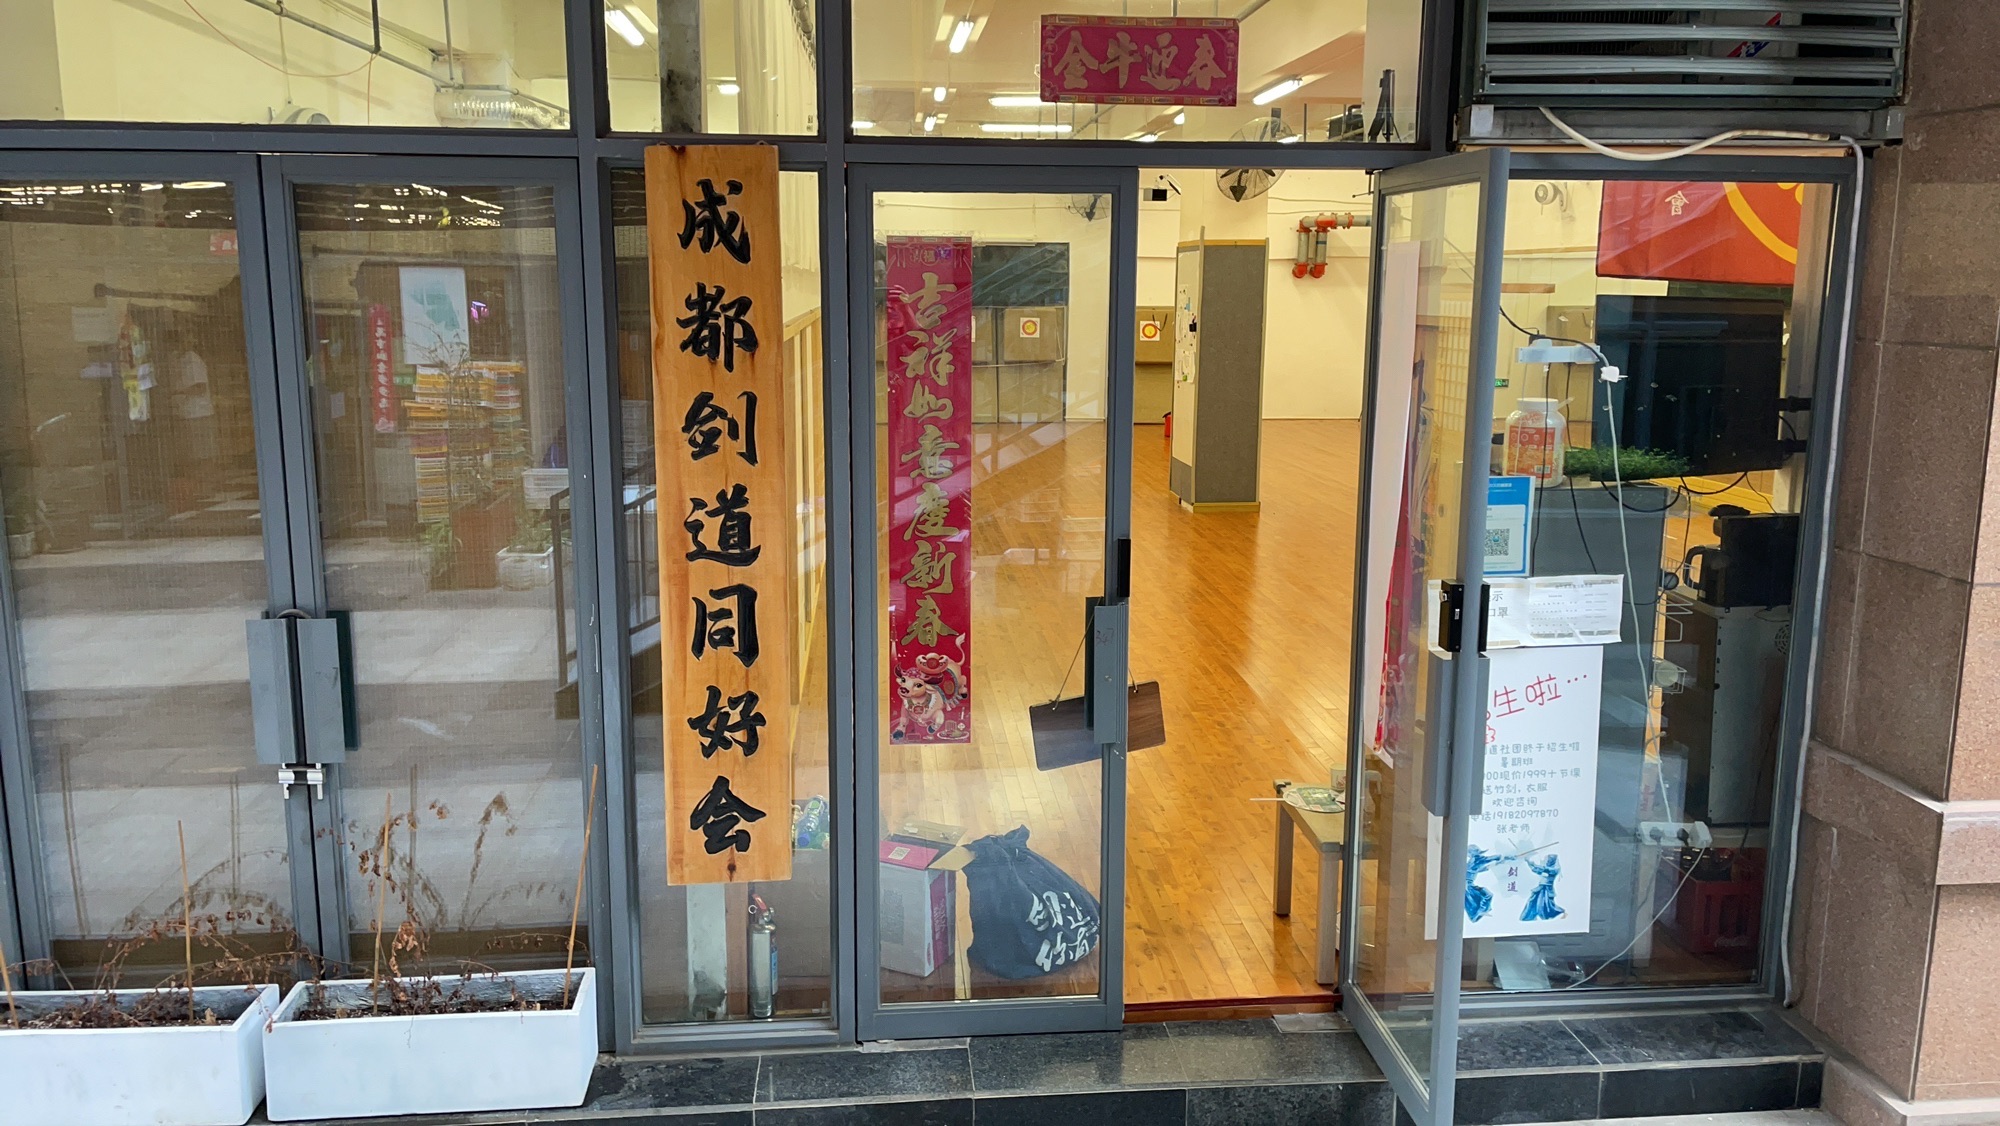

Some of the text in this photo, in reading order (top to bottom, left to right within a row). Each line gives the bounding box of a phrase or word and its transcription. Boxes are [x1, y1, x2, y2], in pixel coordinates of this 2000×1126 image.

[1053, 30, 1227, 91] 金牛迎春
[677, 178, 767, 855] 成都剑道同好会
[1485, 741, 1580, 756] 道社团终于招生啦
[1500, 756, 1534, 769] 暑期班
[1492, 796, 1538, 808] 欢迎咨询
[1497, 823, 1531, 834] 张老师
[1507, 866, 1519, 893] 剑道
